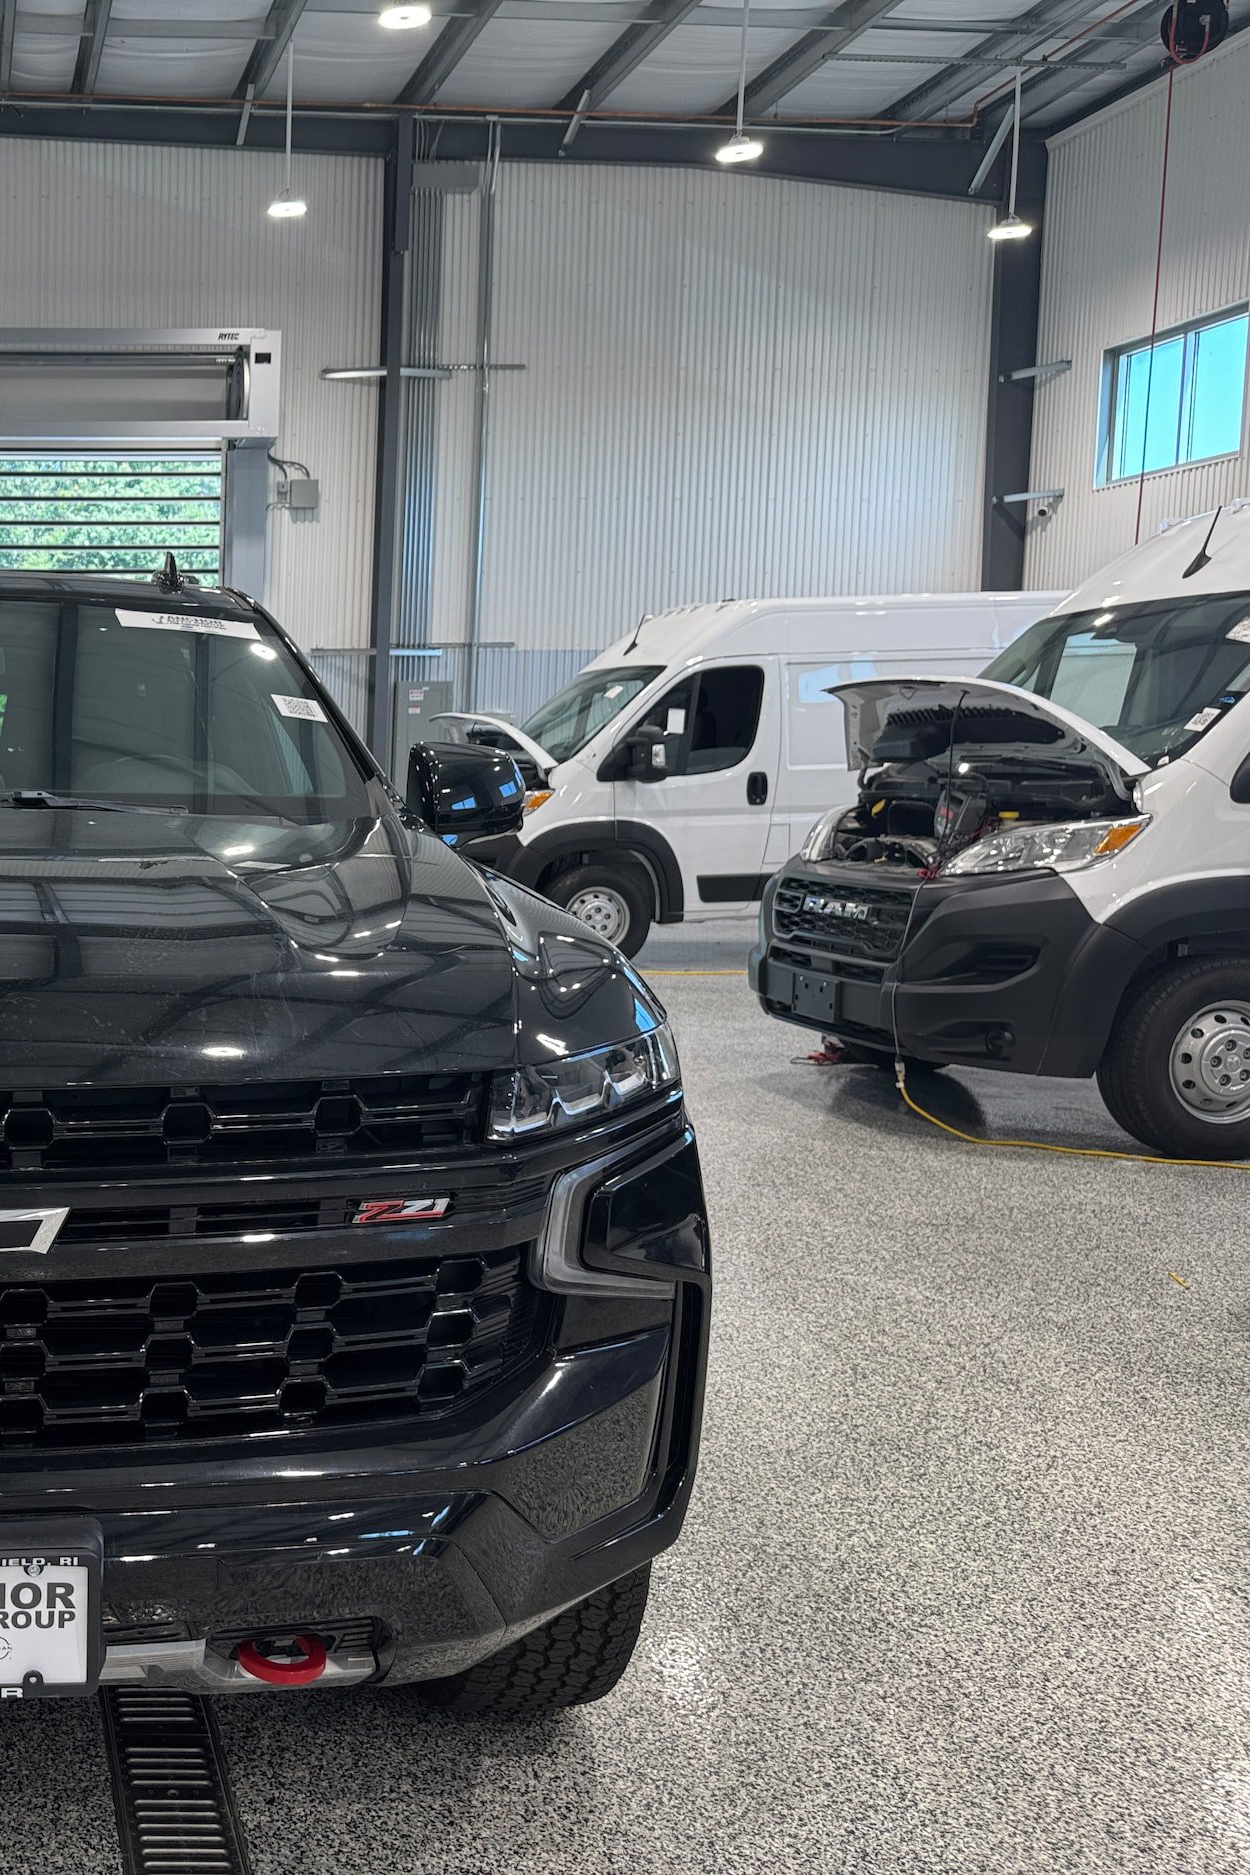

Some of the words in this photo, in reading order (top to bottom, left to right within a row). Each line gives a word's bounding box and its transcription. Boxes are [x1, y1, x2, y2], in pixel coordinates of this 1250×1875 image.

[218, 332, 239, 340] RYTEC
[802, 895, 869, 920] RAM
[59, 1556, 79, 1566] RI
